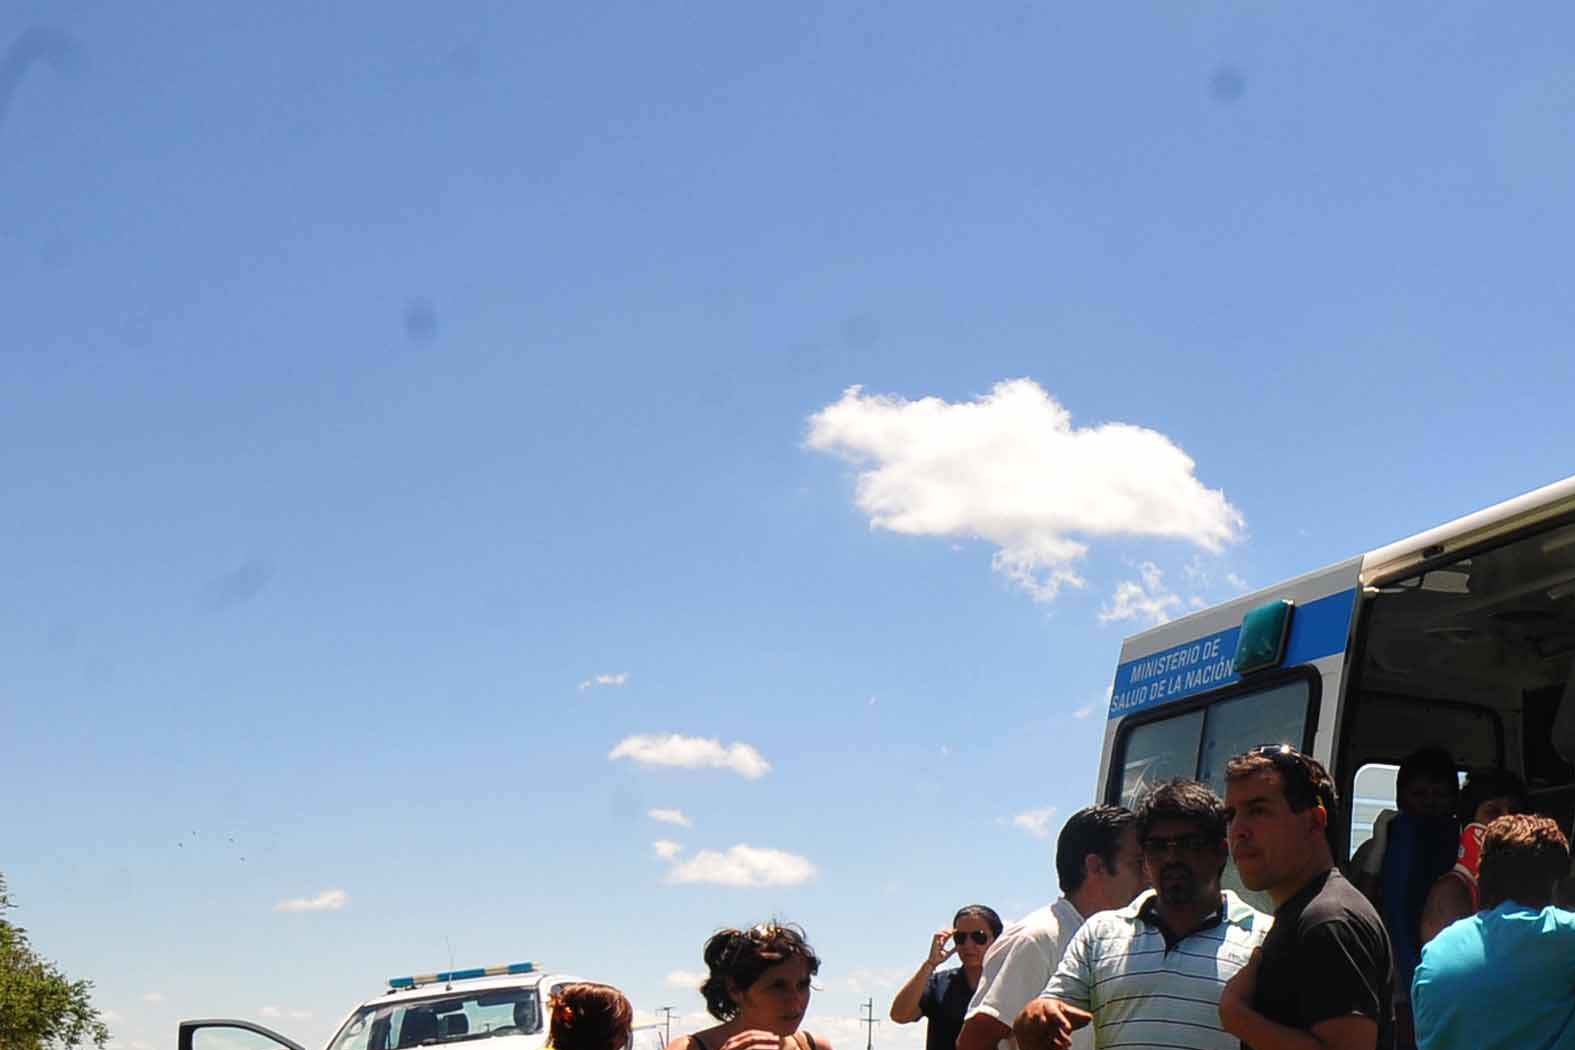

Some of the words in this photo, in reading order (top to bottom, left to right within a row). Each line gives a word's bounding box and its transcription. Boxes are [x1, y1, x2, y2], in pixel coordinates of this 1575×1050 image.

[1111, 684, 1149, 712] SALUD
[1150, 679, 1167, 700] DE
[1168, 675, 1181, 694] LA
[1184, 656, 1235, 690] NACIÓN
[1130, 646, 1200, 683] MINISTERIO
[1202, 638, 1221, 661] DE
